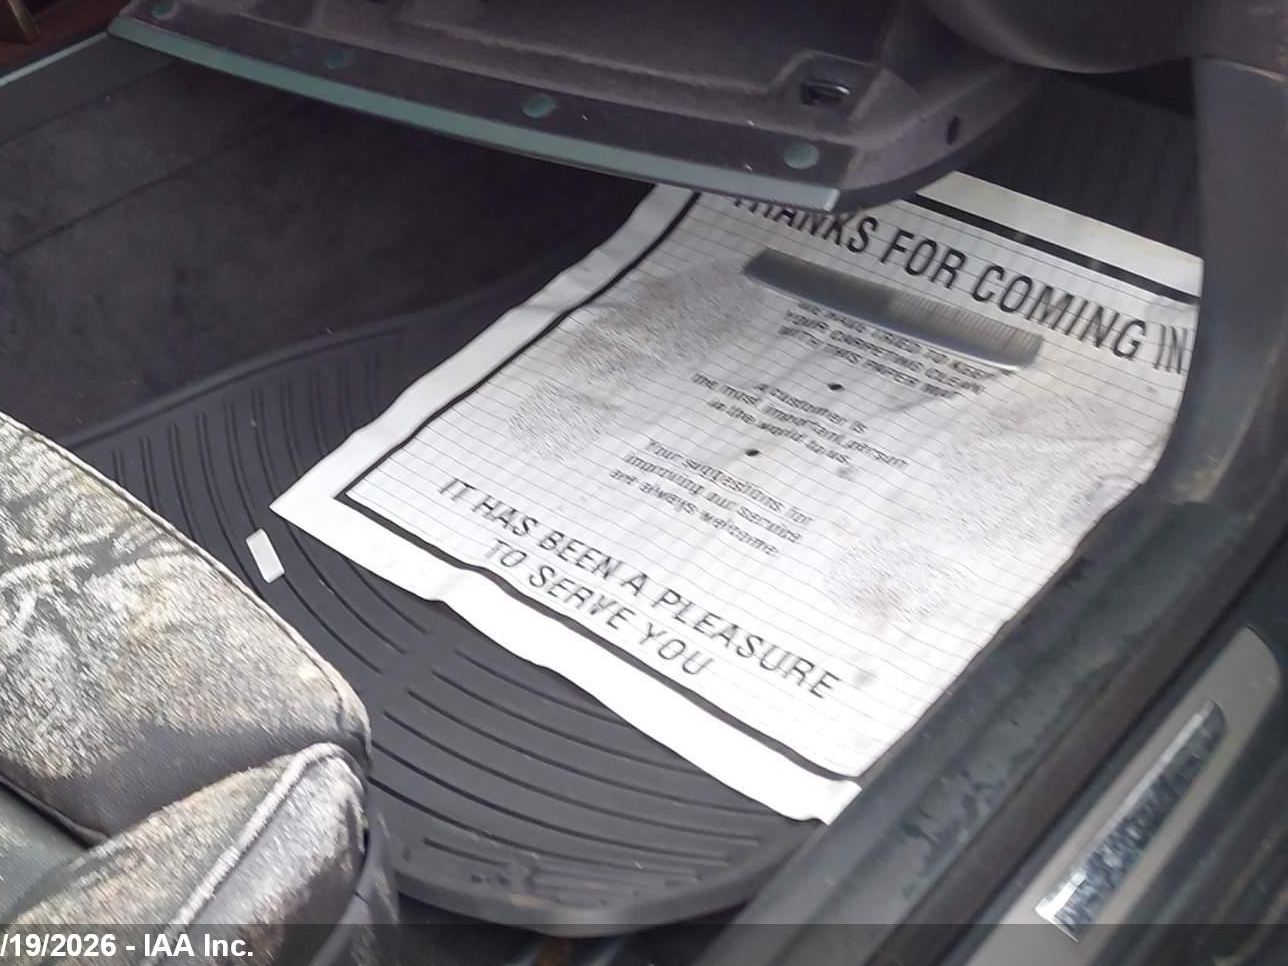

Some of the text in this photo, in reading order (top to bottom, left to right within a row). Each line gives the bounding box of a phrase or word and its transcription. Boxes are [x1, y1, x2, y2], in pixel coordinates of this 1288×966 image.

[880, 227, 967, 291] FOR
[971, 264, 1147, 361] COMING
[1152, 323, 1189, 375] IN
[439, 477, 843, 699] IT HAS BEEN A PLEASURE
[485, 537, 715, 675] TO SERVE YOU
